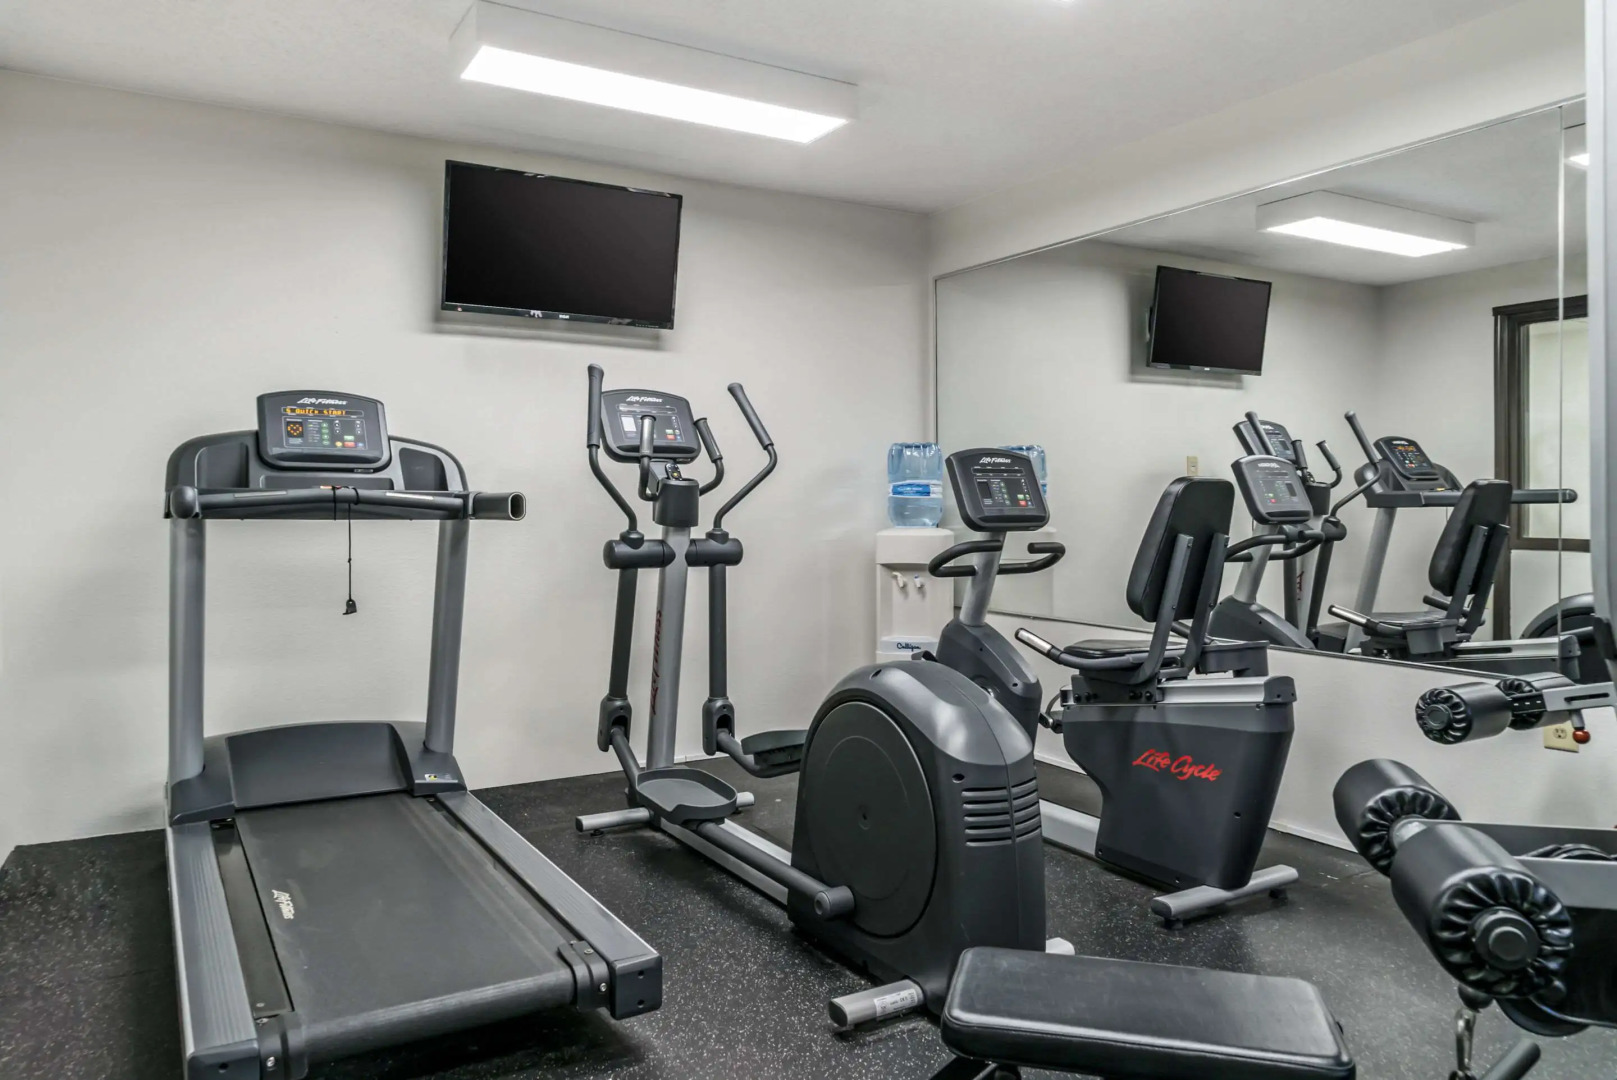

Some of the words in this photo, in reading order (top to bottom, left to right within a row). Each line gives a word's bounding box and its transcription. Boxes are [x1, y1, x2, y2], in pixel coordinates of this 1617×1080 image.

[896, 642, 921, 652] Culligan
[1132, 748, 1171, 772] Life
[1170, 755, 1222, 781] Cycle
